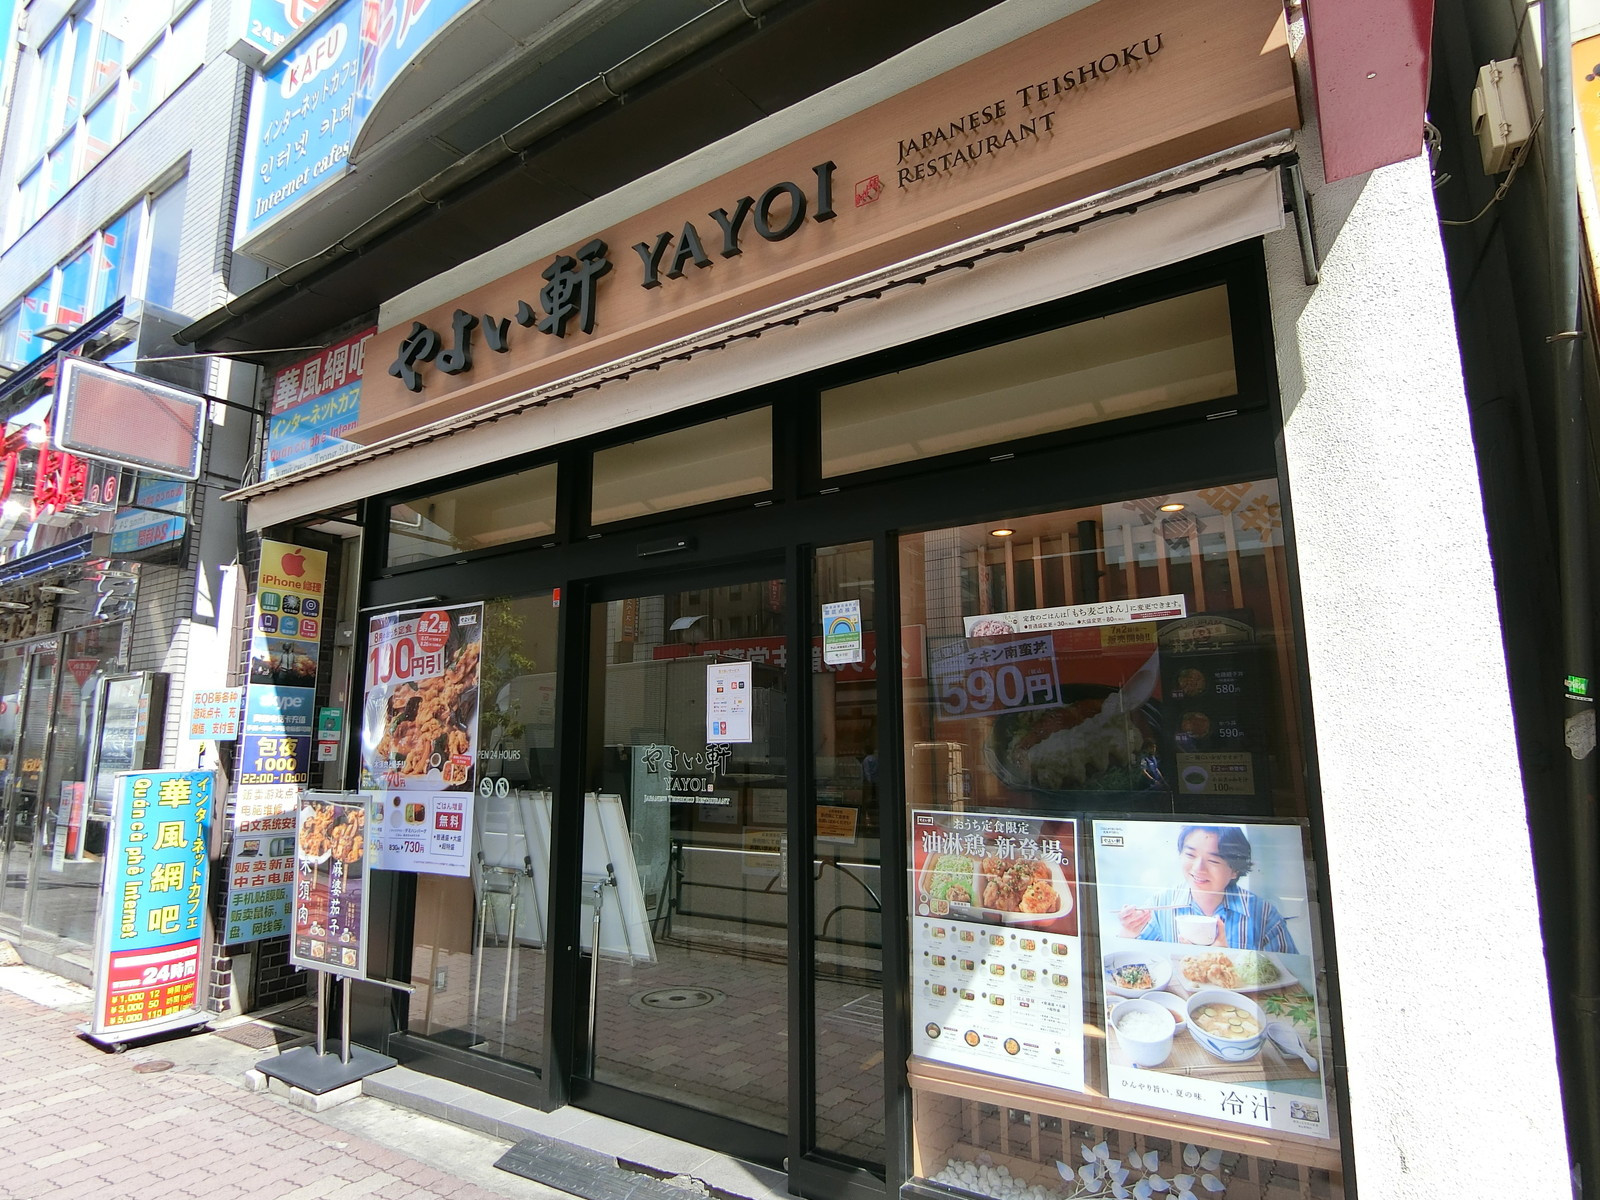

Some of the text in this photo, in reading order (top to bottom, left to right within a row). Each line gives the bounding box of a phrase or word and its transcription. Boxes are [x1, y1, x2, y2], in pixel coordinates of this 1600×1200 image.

[288, 29, 339, 93] KAFU
[263, 58, 358, 145] インターネットカフェ
[896, 33, 1163, 165] JAPANESE TEISHOKU
[259, 96, 353, 184] 인터넷 카페
[897, 111, 1056, 188] RESTAURANT
[253, 140, 350, 220] Internet cafes
[632, 160, 838, 290] YAYOI
[389, 238, 613, 393] やよい軒
[262, 573, 302, 590] iPhone
[419, 613, 449, 633] 第2弾
[967, 640, 1048, 665] チキン南蛮丼
[943, 665, 1054, 715] 590円
[1215, 683, 1241, 694] 580円
[257, 736, 299, 757] 包夜
[1219, 728, 1245, 738] 590円
[255, 757, 297, 772] 1000
[490, 750, 498, 760] 24
[498, 750, 521, 760] HOURS
[641, 743, 732, 777] やよい軒
[131, 778, 152, 819] Quán
[663, 777, 708, 792] YAYOI
[438, 814, 460, 828] 無料
[953, 817, 1030, 835] おうち定食限定
[124, 846, 145, 875] phê
[147, 778, 193, 935] 華風網吧
[186, 775, 210, 930] インターネットカフェ
[404, 840, 425, 854] 730円
[921, 830, 1069, 866] 油淋鶏、新登場。
[297, 859, 313, 926] 木須肉
[328, 859, 345, 937] 麻婆茄子
[120, 880, 144, 940] Internet
[142, 958, 197, 985] 24時間
[1121, 1079, 1208, 1102] ひんやり旨い、夏の味。
[1220, 1090, 1277, 1122] 冷汁
